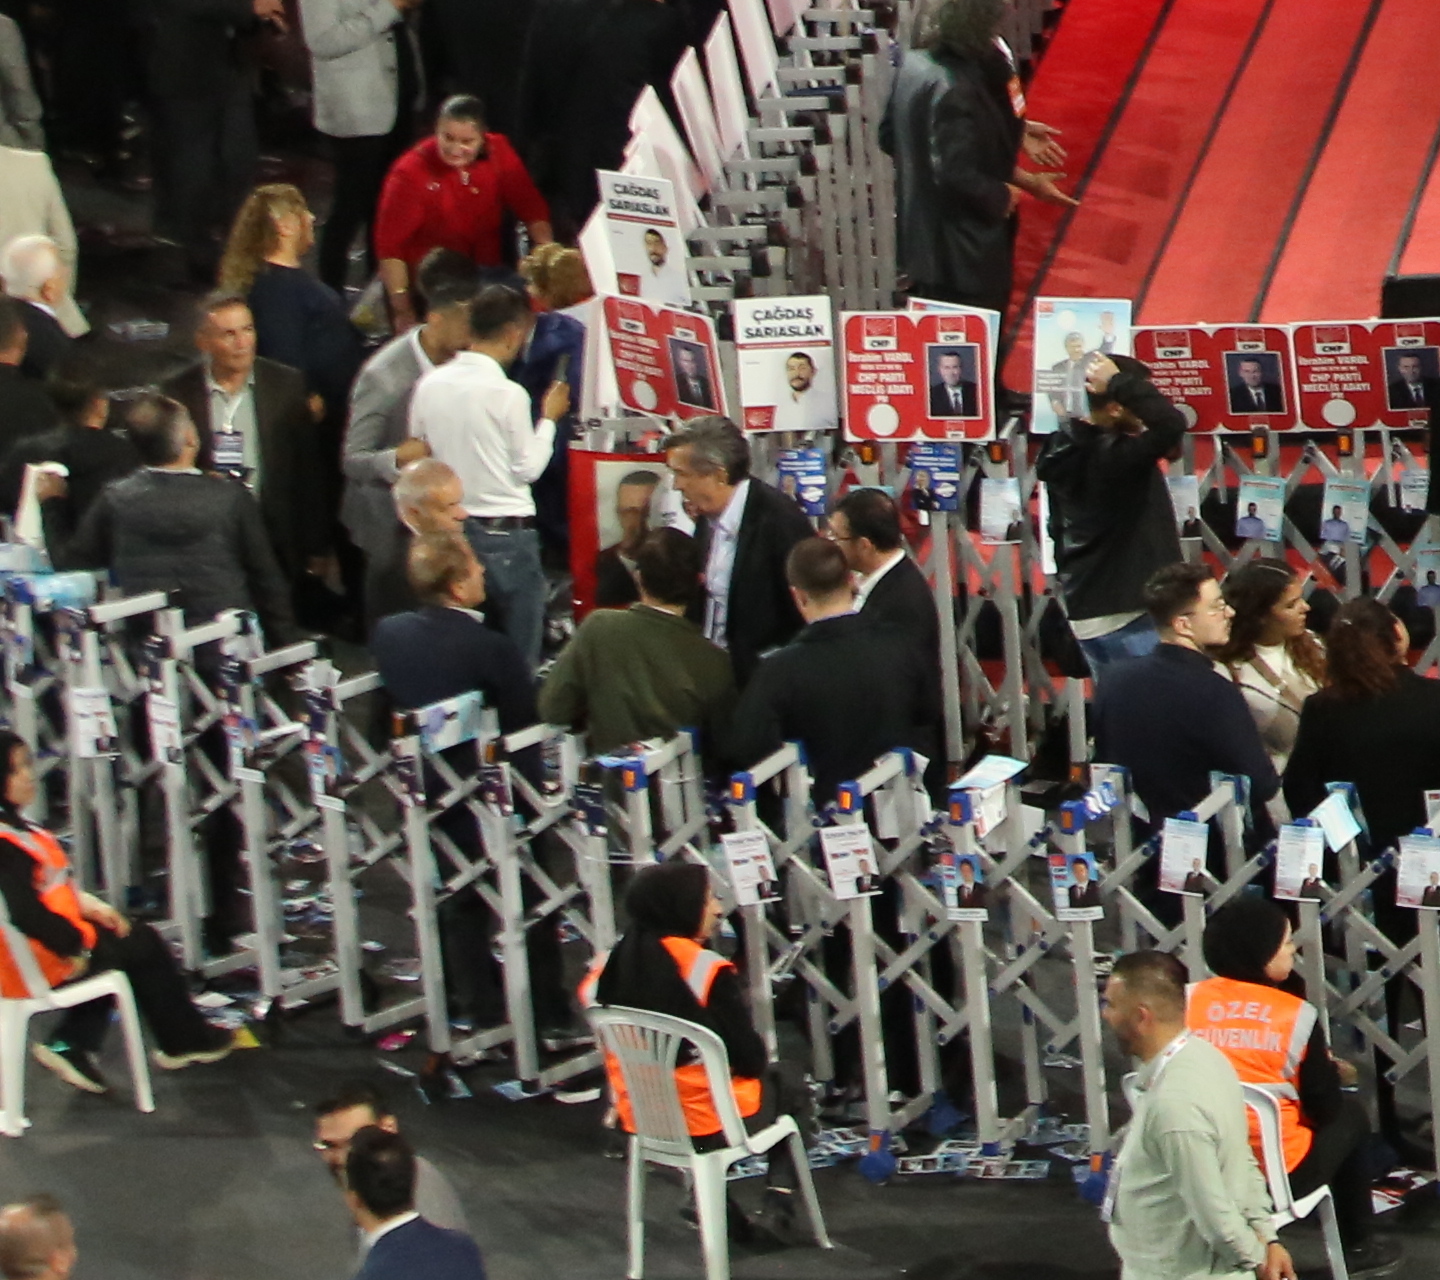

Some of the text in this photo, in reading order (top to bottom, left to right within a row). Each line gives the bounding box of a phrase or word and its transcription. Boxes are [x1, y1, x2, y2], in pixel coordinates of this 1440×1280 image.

[614, 182, 662, 201] ÇAĞDAŞ
[608, 197, 671, 218] SARIASLAN
[752, 305, 815, 324] ÇAĞDAŞ
[744, 324, 825, 339] SARIASLAN
[1207, 999, 1273, 1023] ÖZEL
